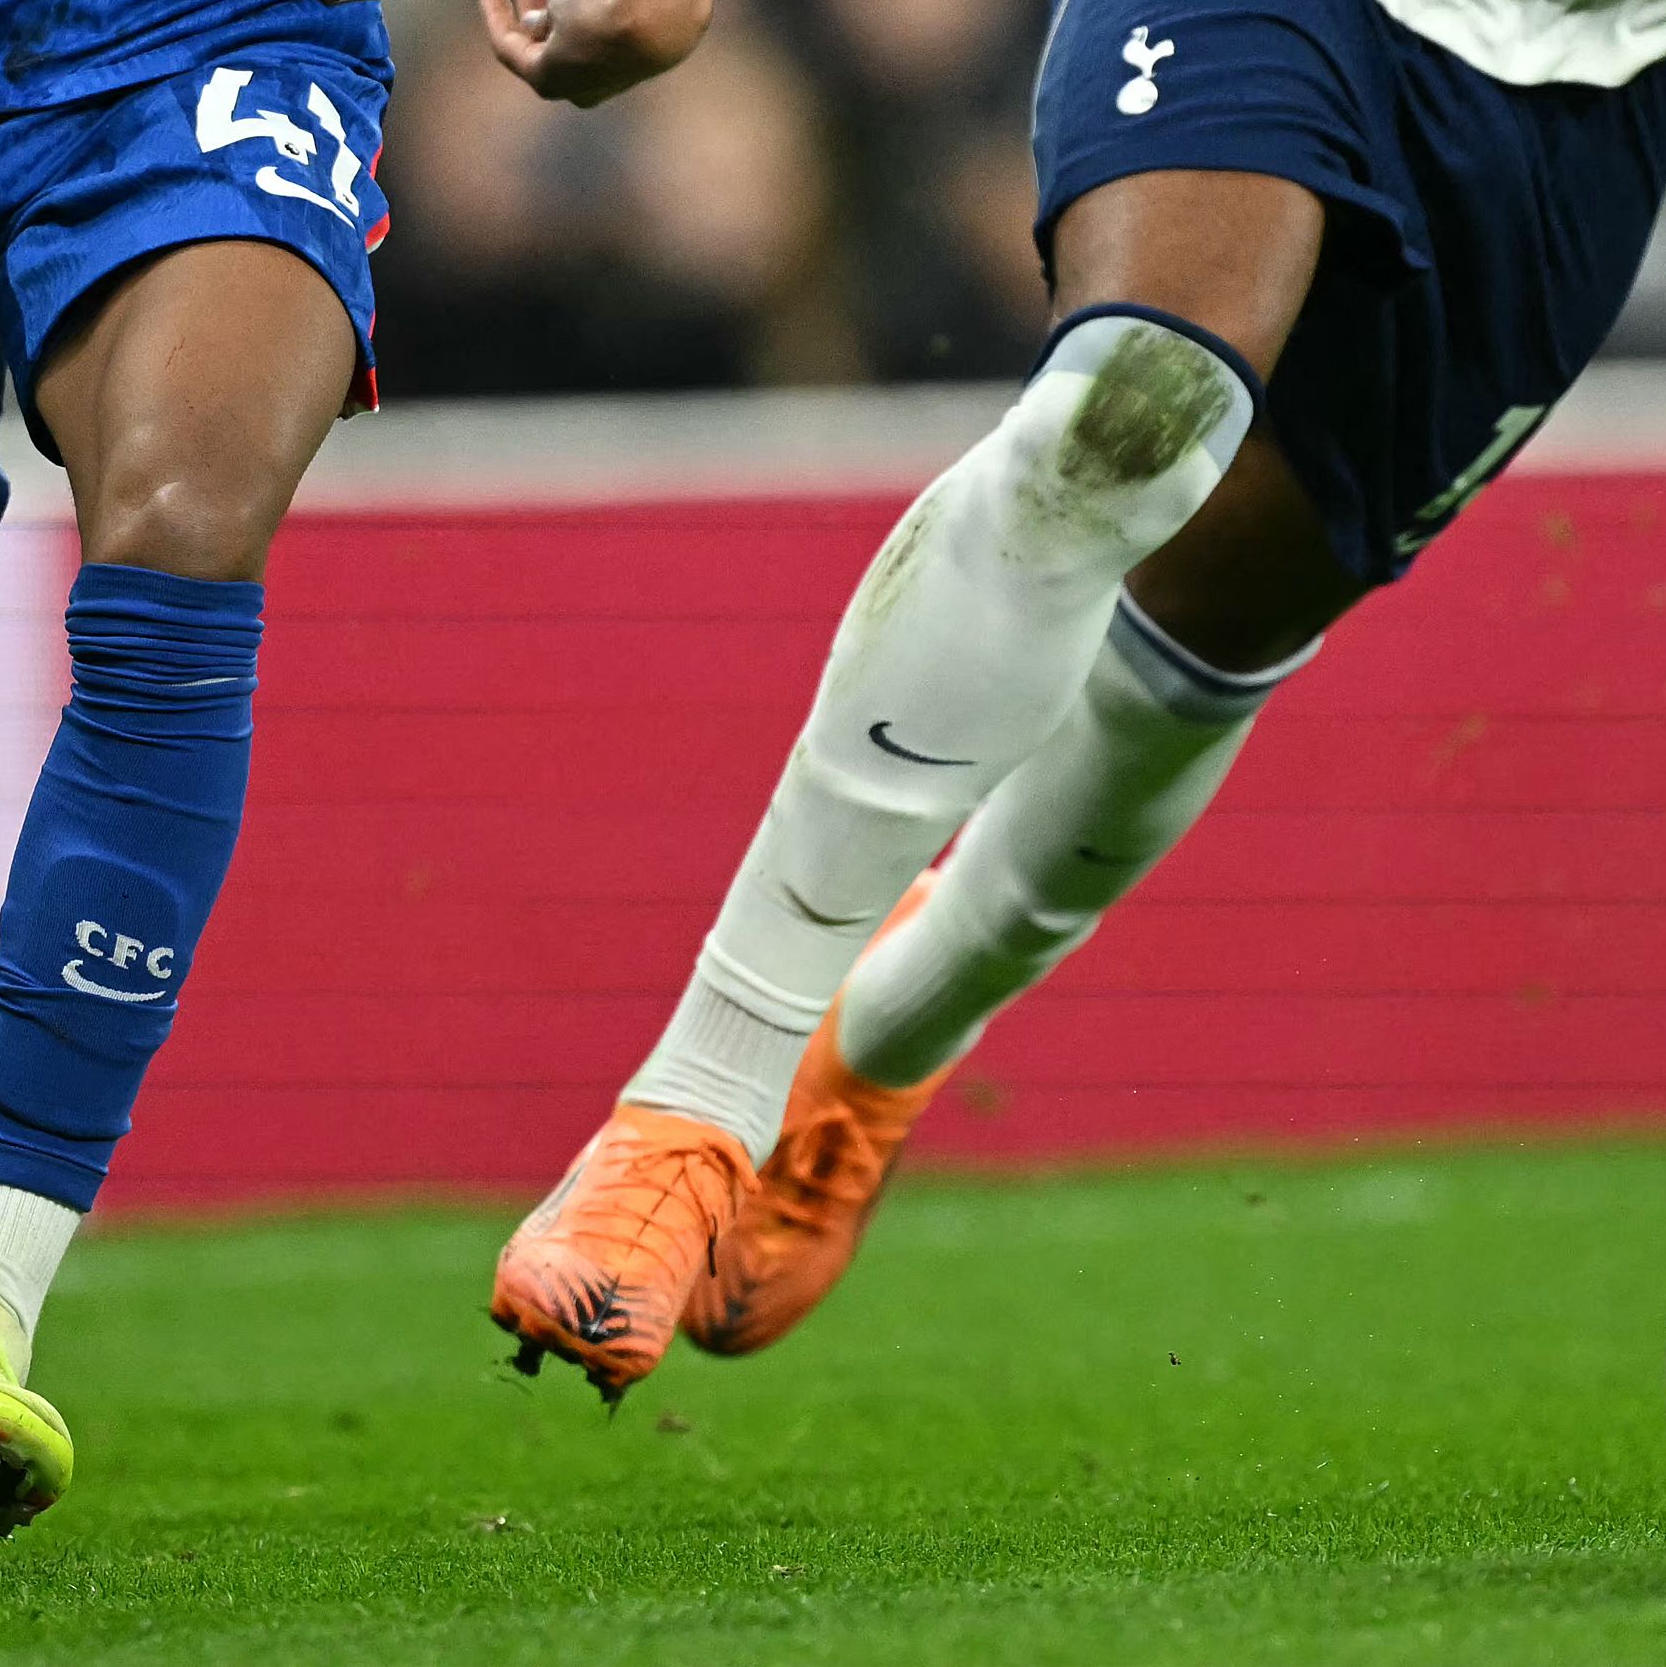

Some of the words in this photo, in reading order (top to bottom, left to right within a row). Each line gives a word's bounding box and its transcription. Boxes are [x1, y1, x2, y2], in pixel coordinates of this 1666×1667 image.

[196, 67, 362, 217] 41
[1414, 404, 1544, 518] 1
[75, 920, 174, 979] CFC
